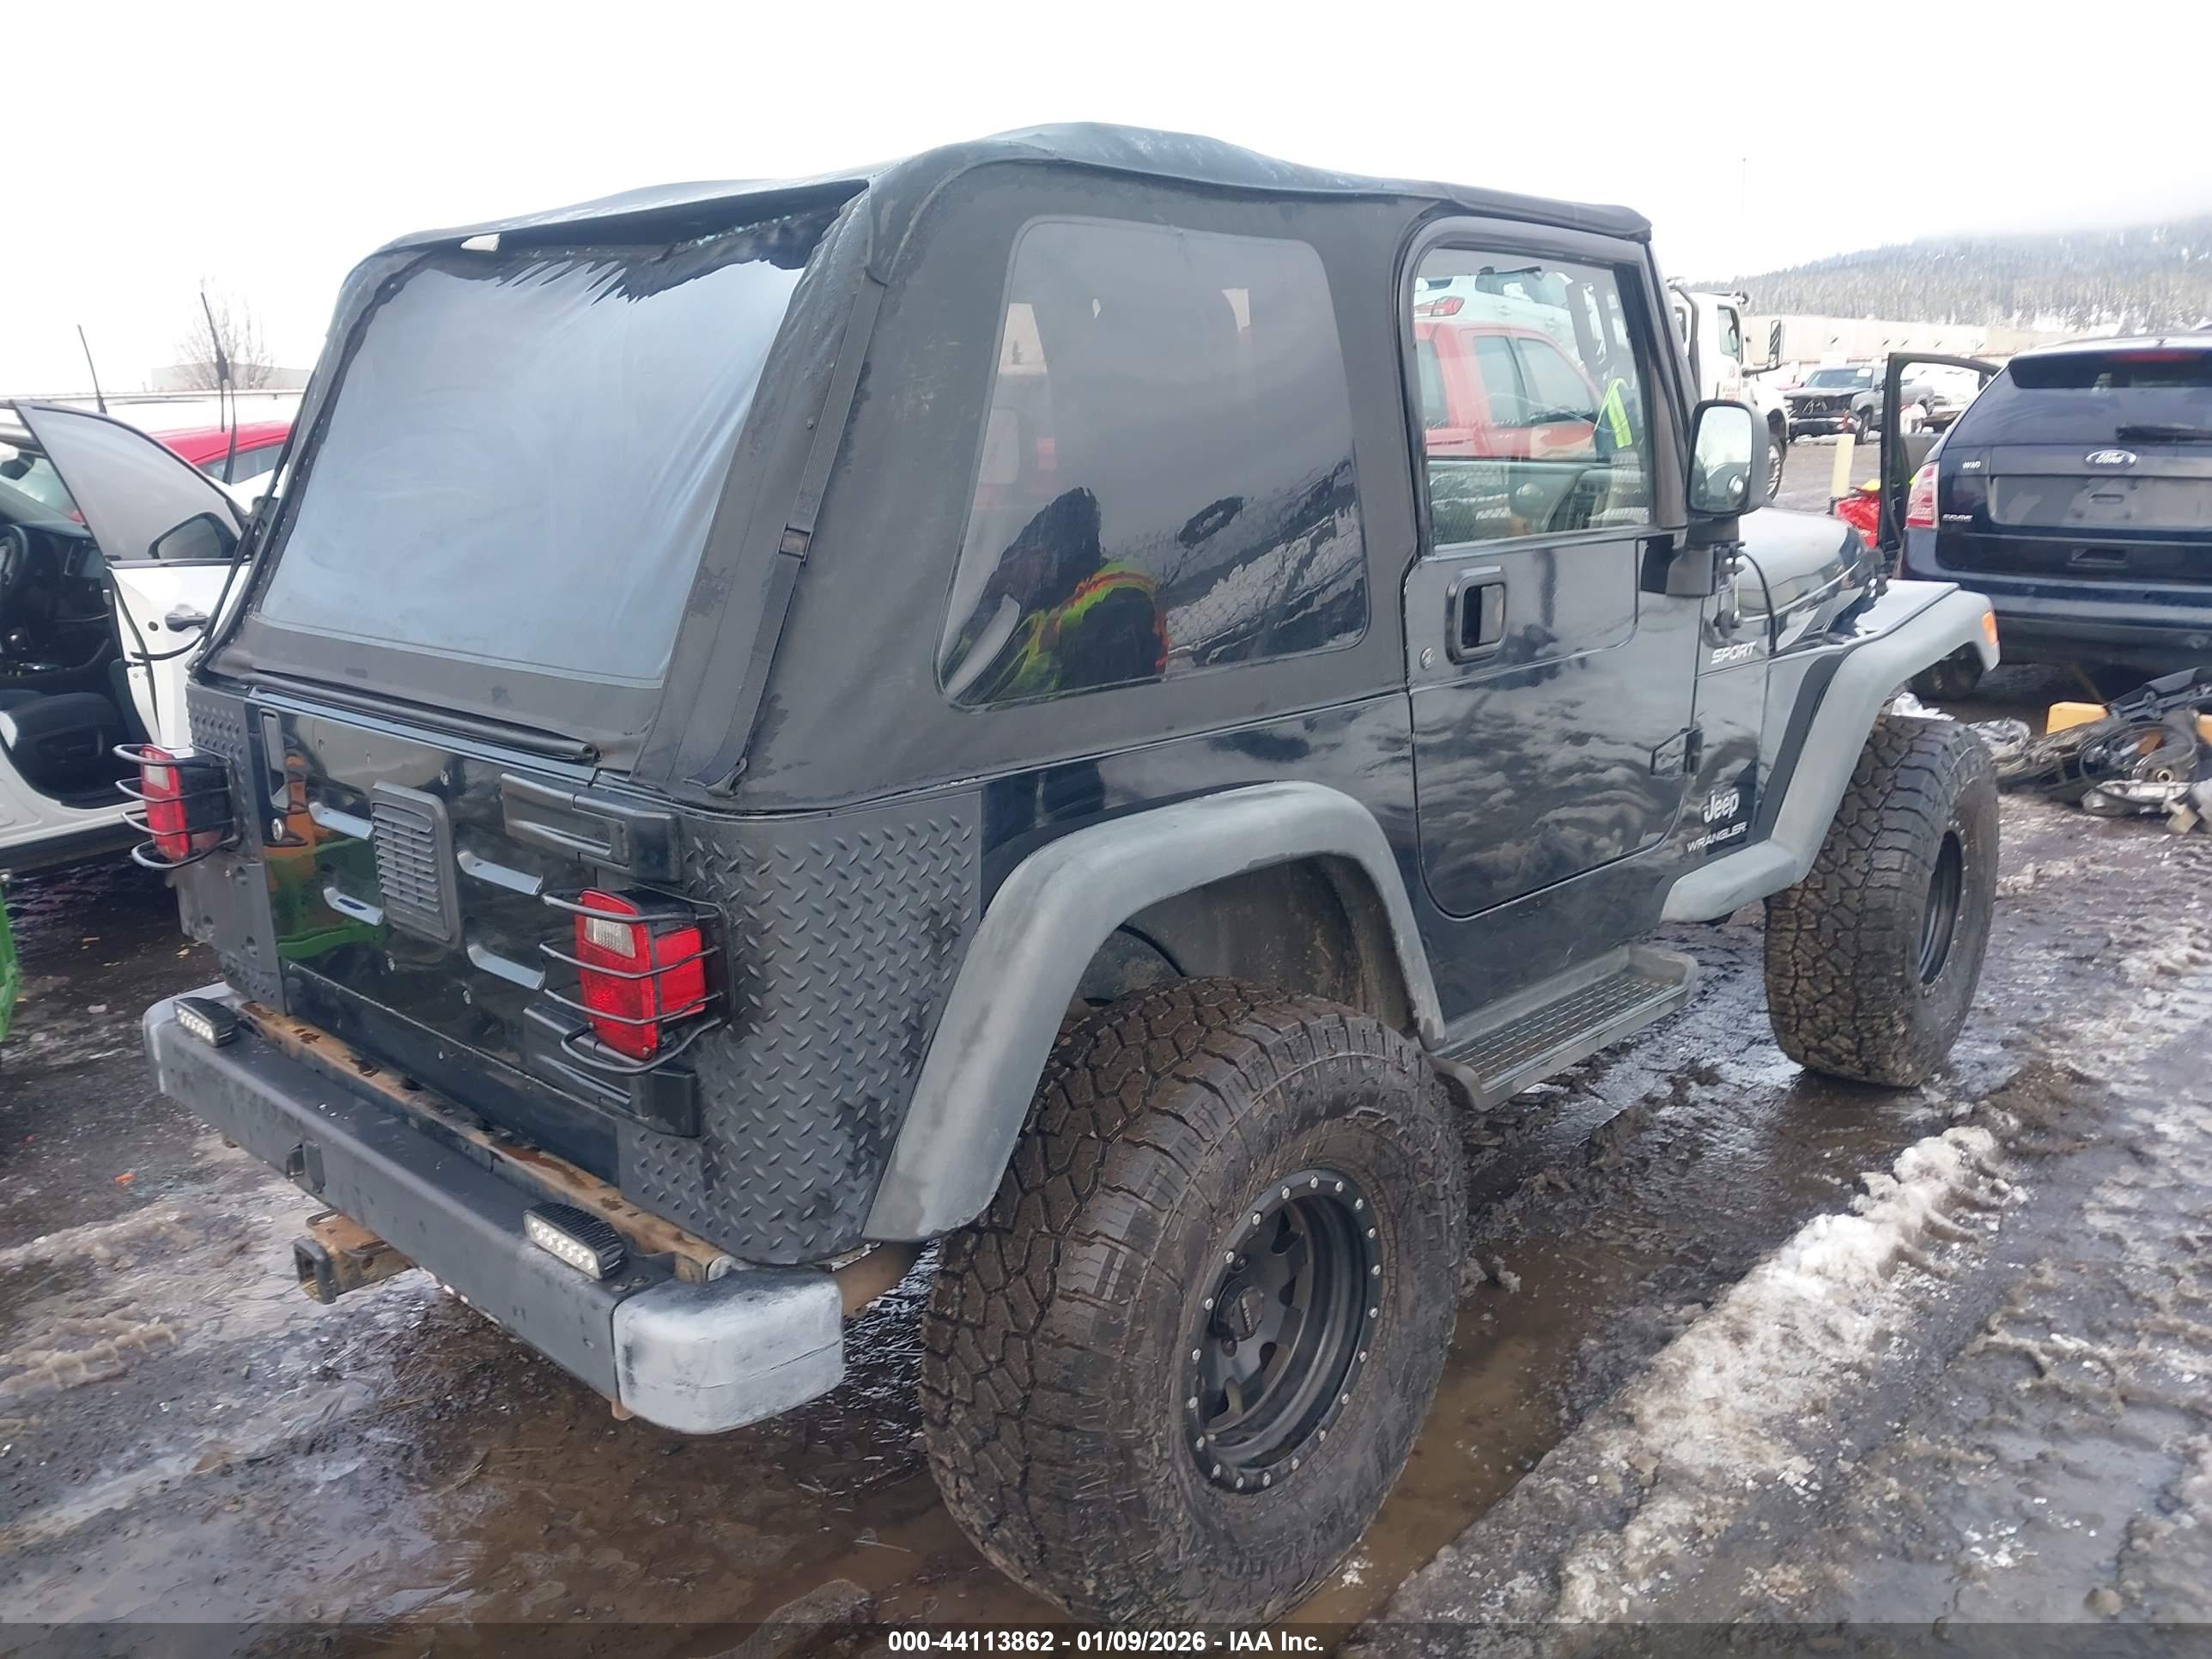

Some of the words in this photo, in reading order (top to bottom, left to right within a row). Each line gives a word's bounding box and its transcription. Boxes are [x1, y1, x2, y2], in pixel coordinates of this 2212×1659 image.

[1711, 640, 1758, 665] SPORT
[1702, 792, 1740, 823] Jeep
[1686, 821, 1747, 853] WRANGLER
